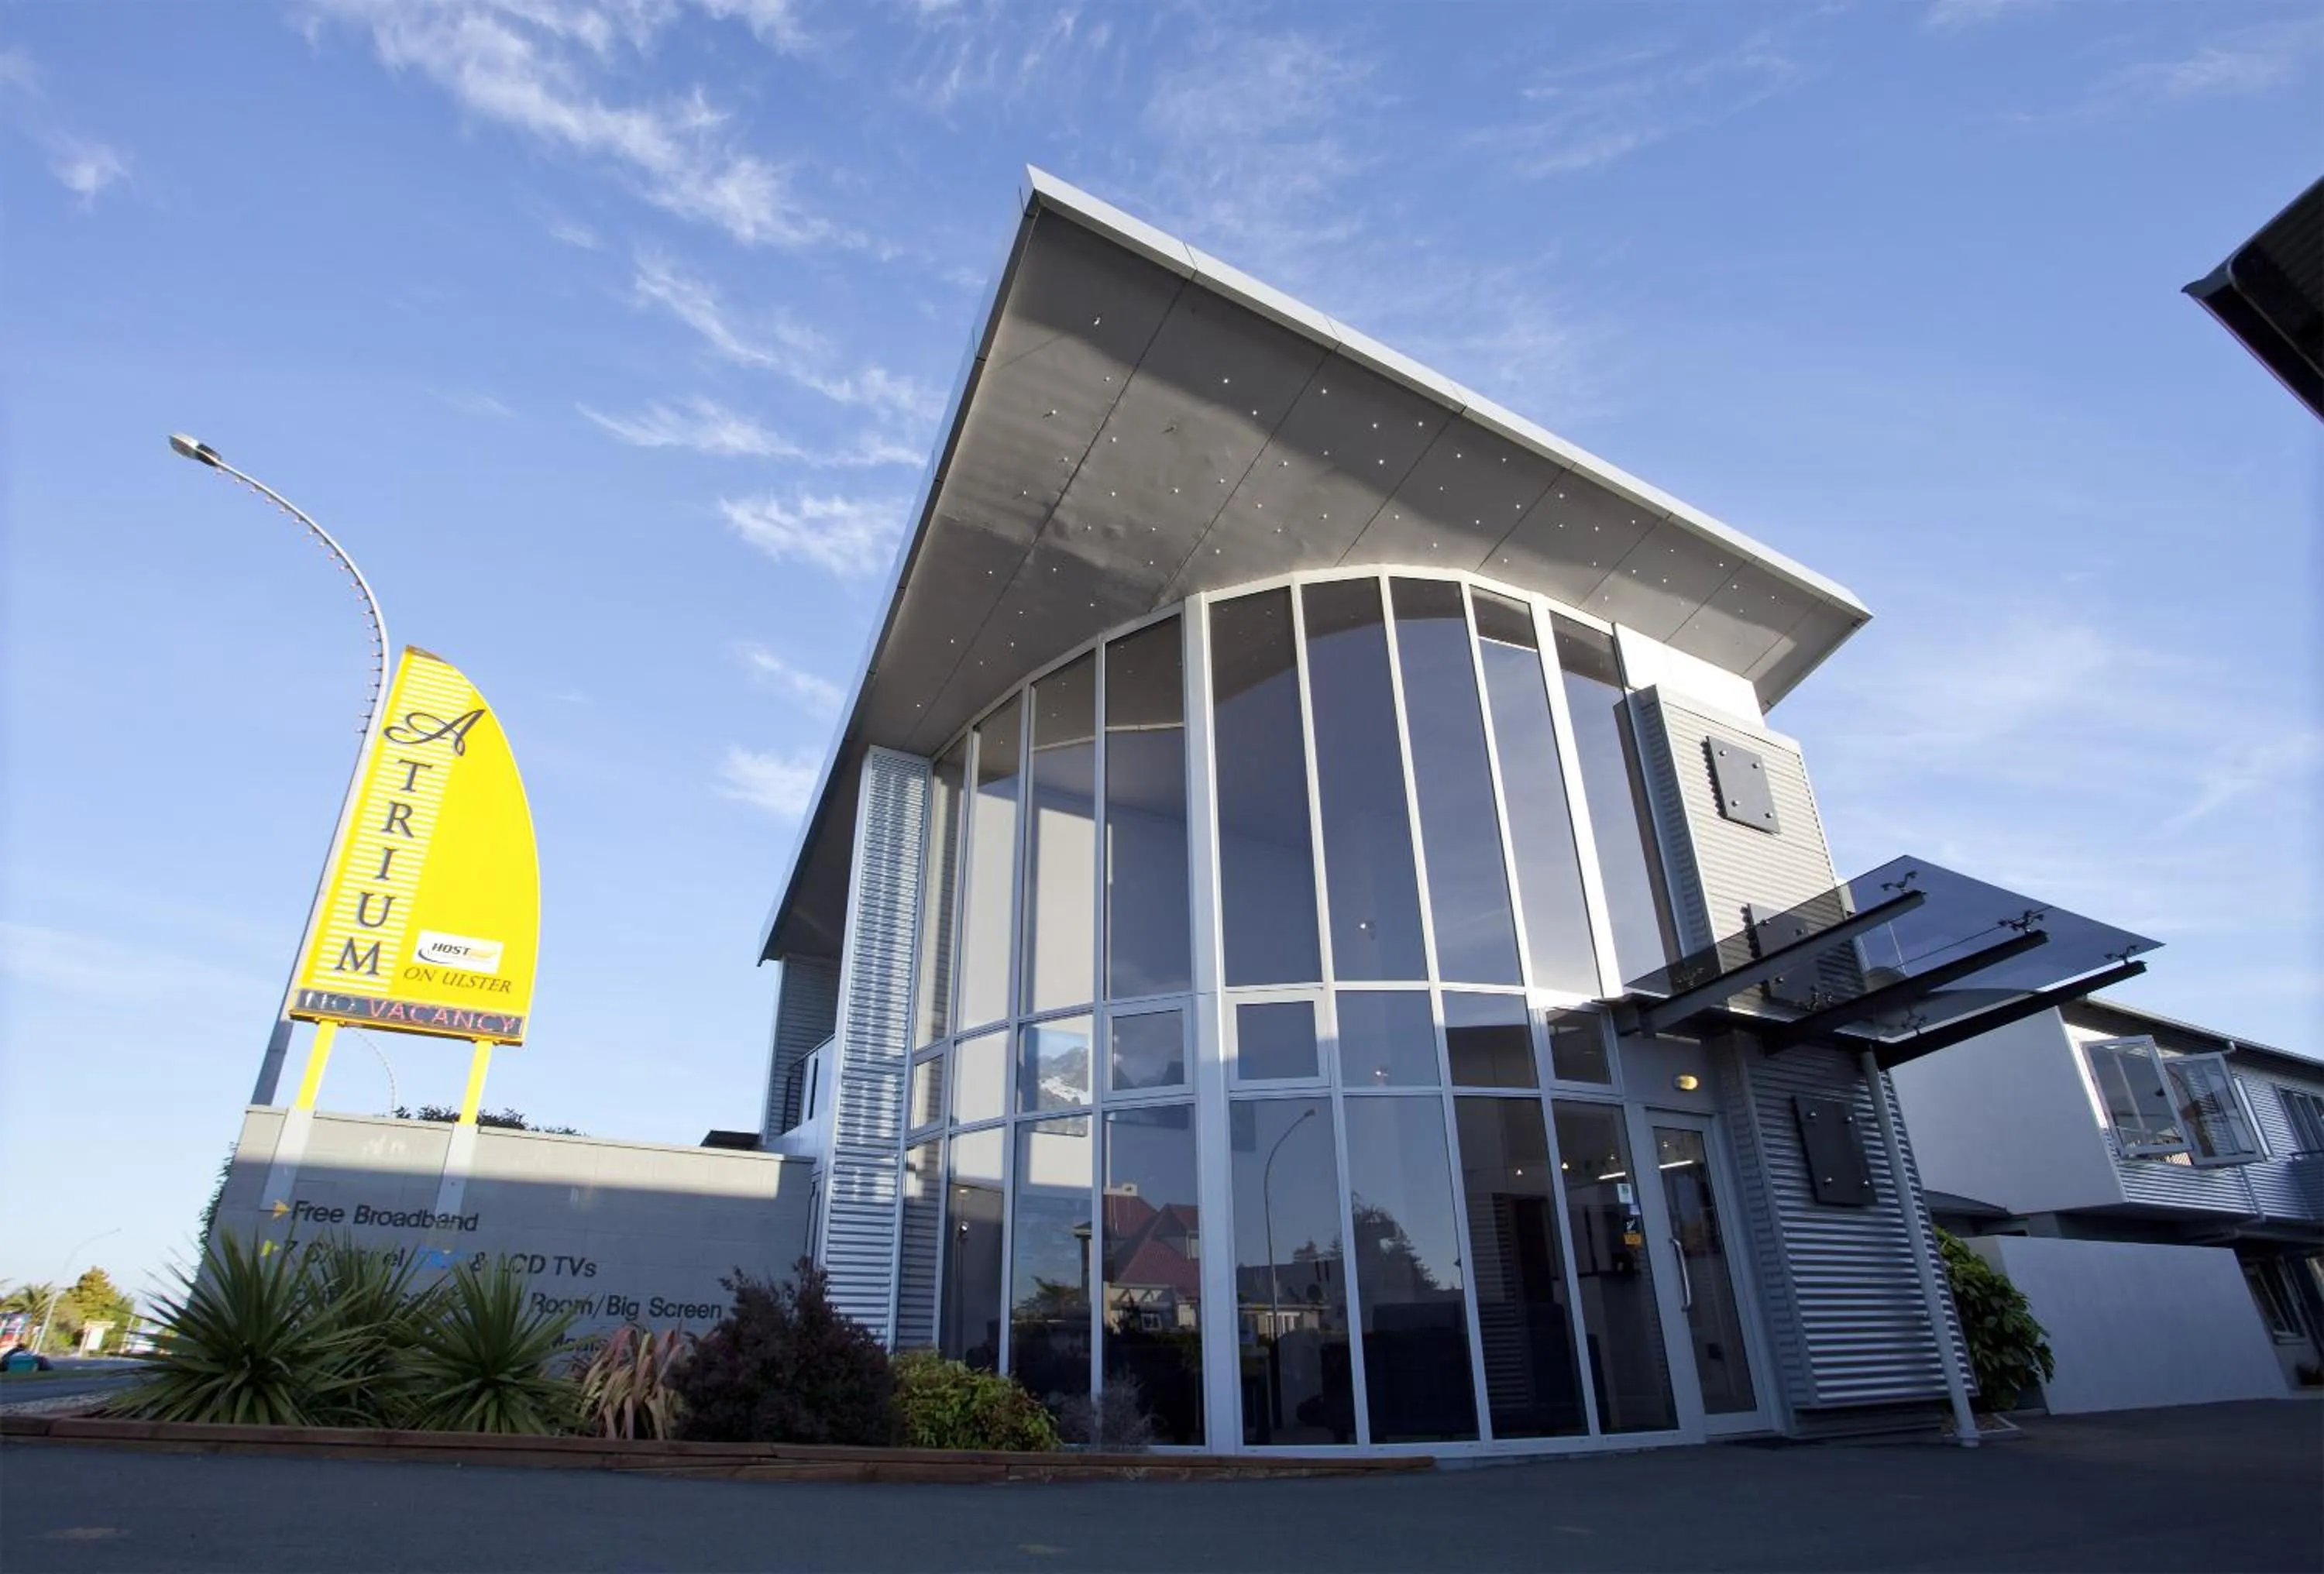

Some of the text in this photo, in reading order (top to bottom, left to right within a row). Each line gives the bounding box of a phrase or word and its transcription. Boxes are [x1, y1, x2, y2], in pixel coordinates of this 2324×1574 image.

[335, 709, 486, 976] ATRIUM
[431, 942, 472, 956] HOST
[404, 966, 513, 994] ON ULSTER
[368, 996, 517, 1033] VACANCY
[291, 1200, 480, 1232] Free Broadband
[553, 1255, 597, 1278] TVs
[648, 1296, 722, 1320] Screen
